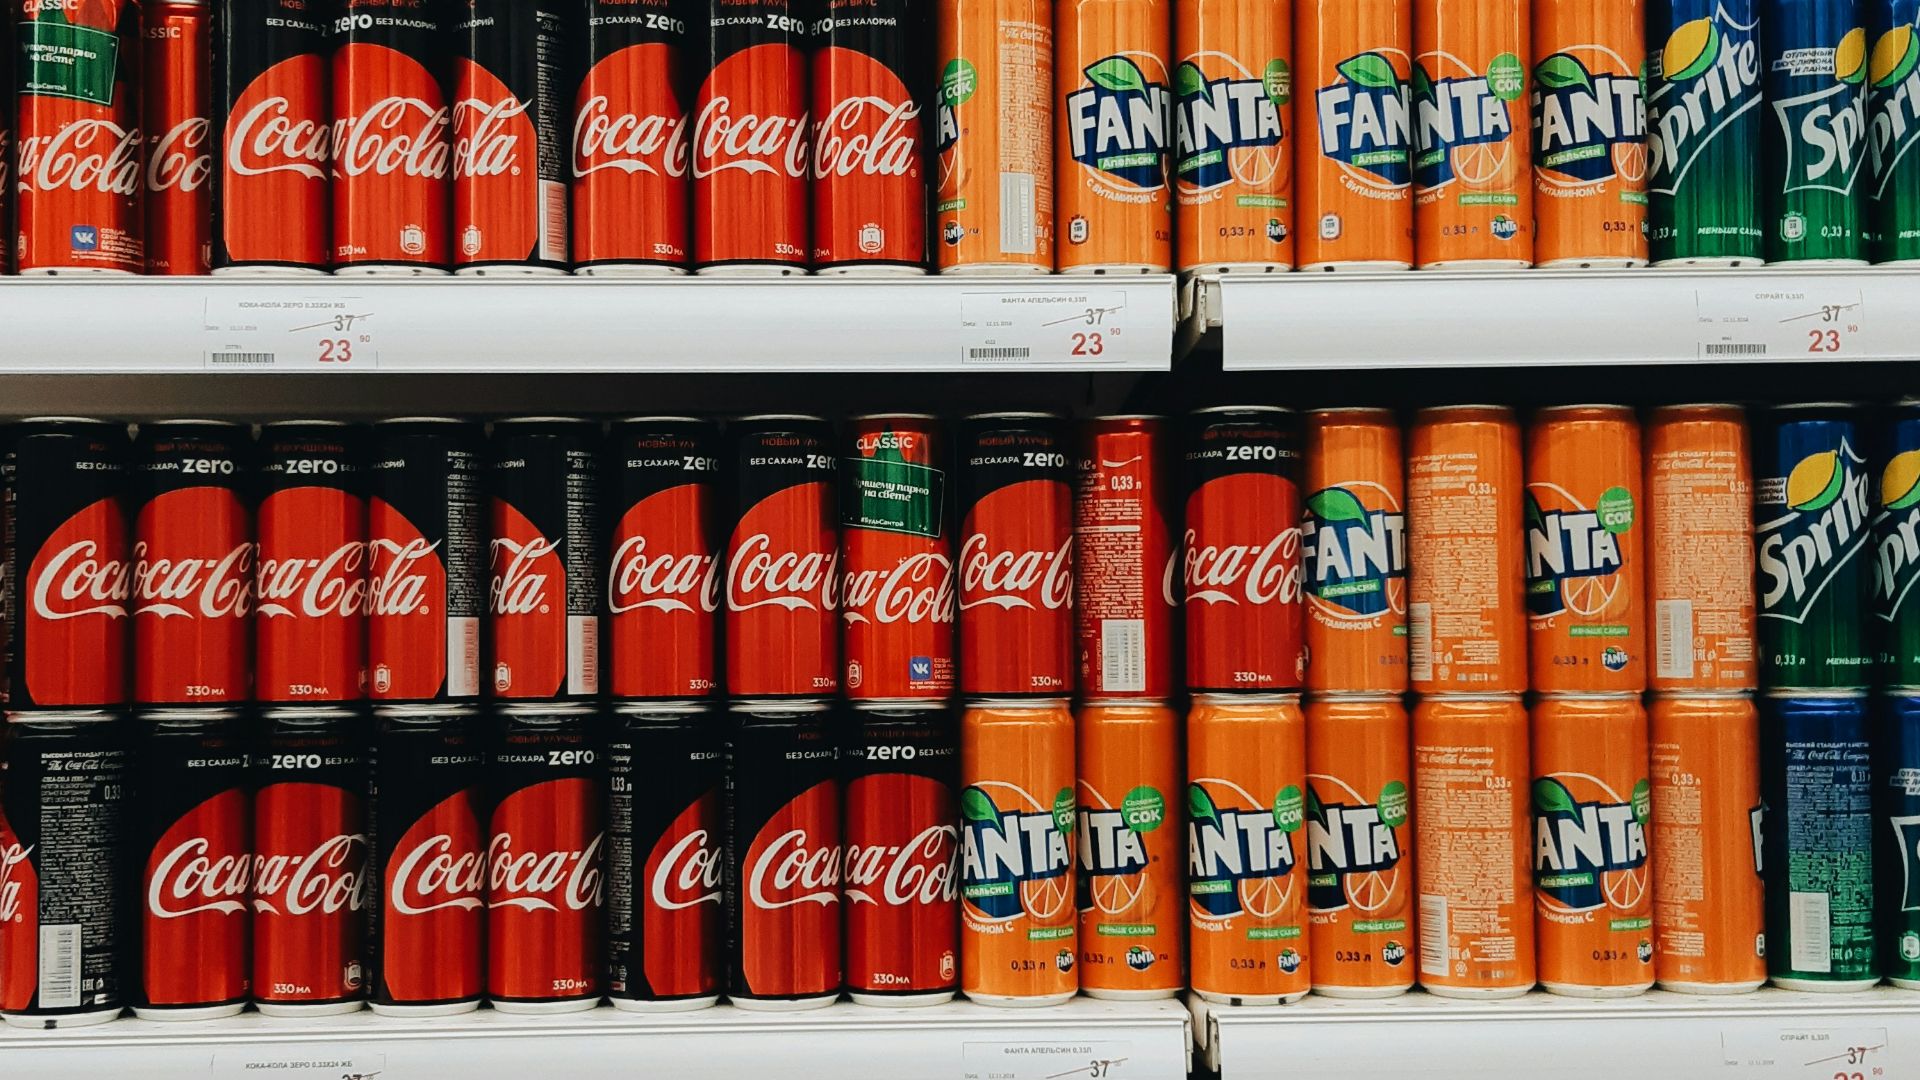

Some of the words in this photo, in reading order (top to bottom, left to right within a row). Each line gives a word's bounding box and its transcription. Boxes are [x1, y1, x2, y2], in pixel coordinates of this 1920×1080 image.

[266, 17, 285, 26] БЕЗ
[334, 14, 373, 33] zero
[375, 17, 393, 25] БЕЗ
[589, 17, 604, 26] БЕЗ
[605, 16, 643, 25] САХАРА
[646, 13, 685, 34] zero
[710, 17, 725, 27] БЕЗ
[727, 16, 763, 25] САХАРА
[767, 14, 804, 34] zero
[835, 18, 851, 27] БЕЗ
[853, 17, 897, 27] КАЛОРИЙ
[946, 82, 973, 99] СОК
[1494, 79, 1521, 92] СОК
[1546, 147, 1601, 165] Апельсин
[1102, 157, 1155, 169] Апельсин
[1219, 226, 1245, 237] 0,33
[1602, 221, 1626, 231] 0,33
[1697, 227, 1738, 235] МЕНЬШЕ
[1820, 227, 1842, 237] 0,33
[654, 243, 673, 254] 330
[775, 243, 794, 254] 330
[1085, 308, 1105, 325] 37
[1821, 305, 1841, 322] 37
[334, 314, 354, 331] 37
[1110, 327, 1121, 336] 90
[1847, 324, 1858, 333] 90
[359, 335, 371, 343] 90
[1071, 332, 1104, 356] 23
[1808, 329, 1841, 353] 23
[319, 339, 353, 363] 23
[856, 437, 913, 450] CLASSIC
[1225, 445, 1276, 461] zero
[76, 461, 94, 470] БЕЗ
[627, 460, 642, 468] БЕЗ
[644, 459, 680, 468] САХАРА
[750, 458, 766, 466] БЕЗ
[767, 457, 803, 465] САХАРА
[984, 457, 1020, 465] САХАРА
[1023, 452, 1064, 468] zero
[182, 458, 233, 475] zero
[286, 458, 338, 475] zero
[1111, 475, 1133, 491] 0,33
[1469, 482, 1491, 495] 0,33
[896, 482, 929, 497] парню
[864, 489, 877, 499] на
[878, 489, 911, 503] свете
[1604, 511, 1631, 525] СОК
[1760, 466, 1869, 609] Sprite
[1322, 584, 1377, 597] Апельсин
[1602, 651, 1628, 665] FANTA
[1775, 654, 1796, 665] 0,33
[1826, 657, 1860, 665] МЕНЬШЕ
[813, 677, 829, 687] 330
[1031, 676, 1051, 687] 330
[1234, 671, 1256, 682] 330
[1258, 674, 1272, 682] мл
[289, 684, 312, 695] 330
[690, 679, 708, 689] 330
[186, 685, 209, 696] 330
[549, 750, 594, 765] zero
[691, 753, 705, 761] БЕЗ
[786, 752, 803, 761] БЕЗ
[867, 745, 915, 760] zero
[919, 749, 934, 757] БЕЗ
[188, 759, 206, 767] БЕЗ
[272, 754, 322, 769] zero
[432, 756, 449, 764] БЕЗ
[510, 755, 545, 763] САХАРА
[1485, 776, 1506, 788] 0,33
[1672, 772, 1693, 785] 0,33
[1129, 811, 1161, 824] СОК
[1279, 809, 1303, 824] СОК
[1384, 806, 1407, 820] СОК
[1127, 925, 1155, 935] САХАРА
[1085, 953, 1105, 964] 0,33
[1125, 952, 1155, 965] FANTA
[1335, 951, 1361, 961] 0,33
[1592, 950, 1617, 962] 0,33
[1011, 960, 1036, 971] 0,33
[1230, 959, 1255, 969] 0,33
[873, 973, 894, 984] 330
[895, 976, 910, 984] мл
[274, 983, 295, 994] 330
[296, 986, 311, 994] мл
[553, 979, 575, 990] 330
[1847, 1046, 1866, 1065] 37
[246, 1062, 288, 1070] КОКА-КОЛА
[1090, 1060, 1110, 1078] 37
[1872, 1067, 1883, 1076] 90
